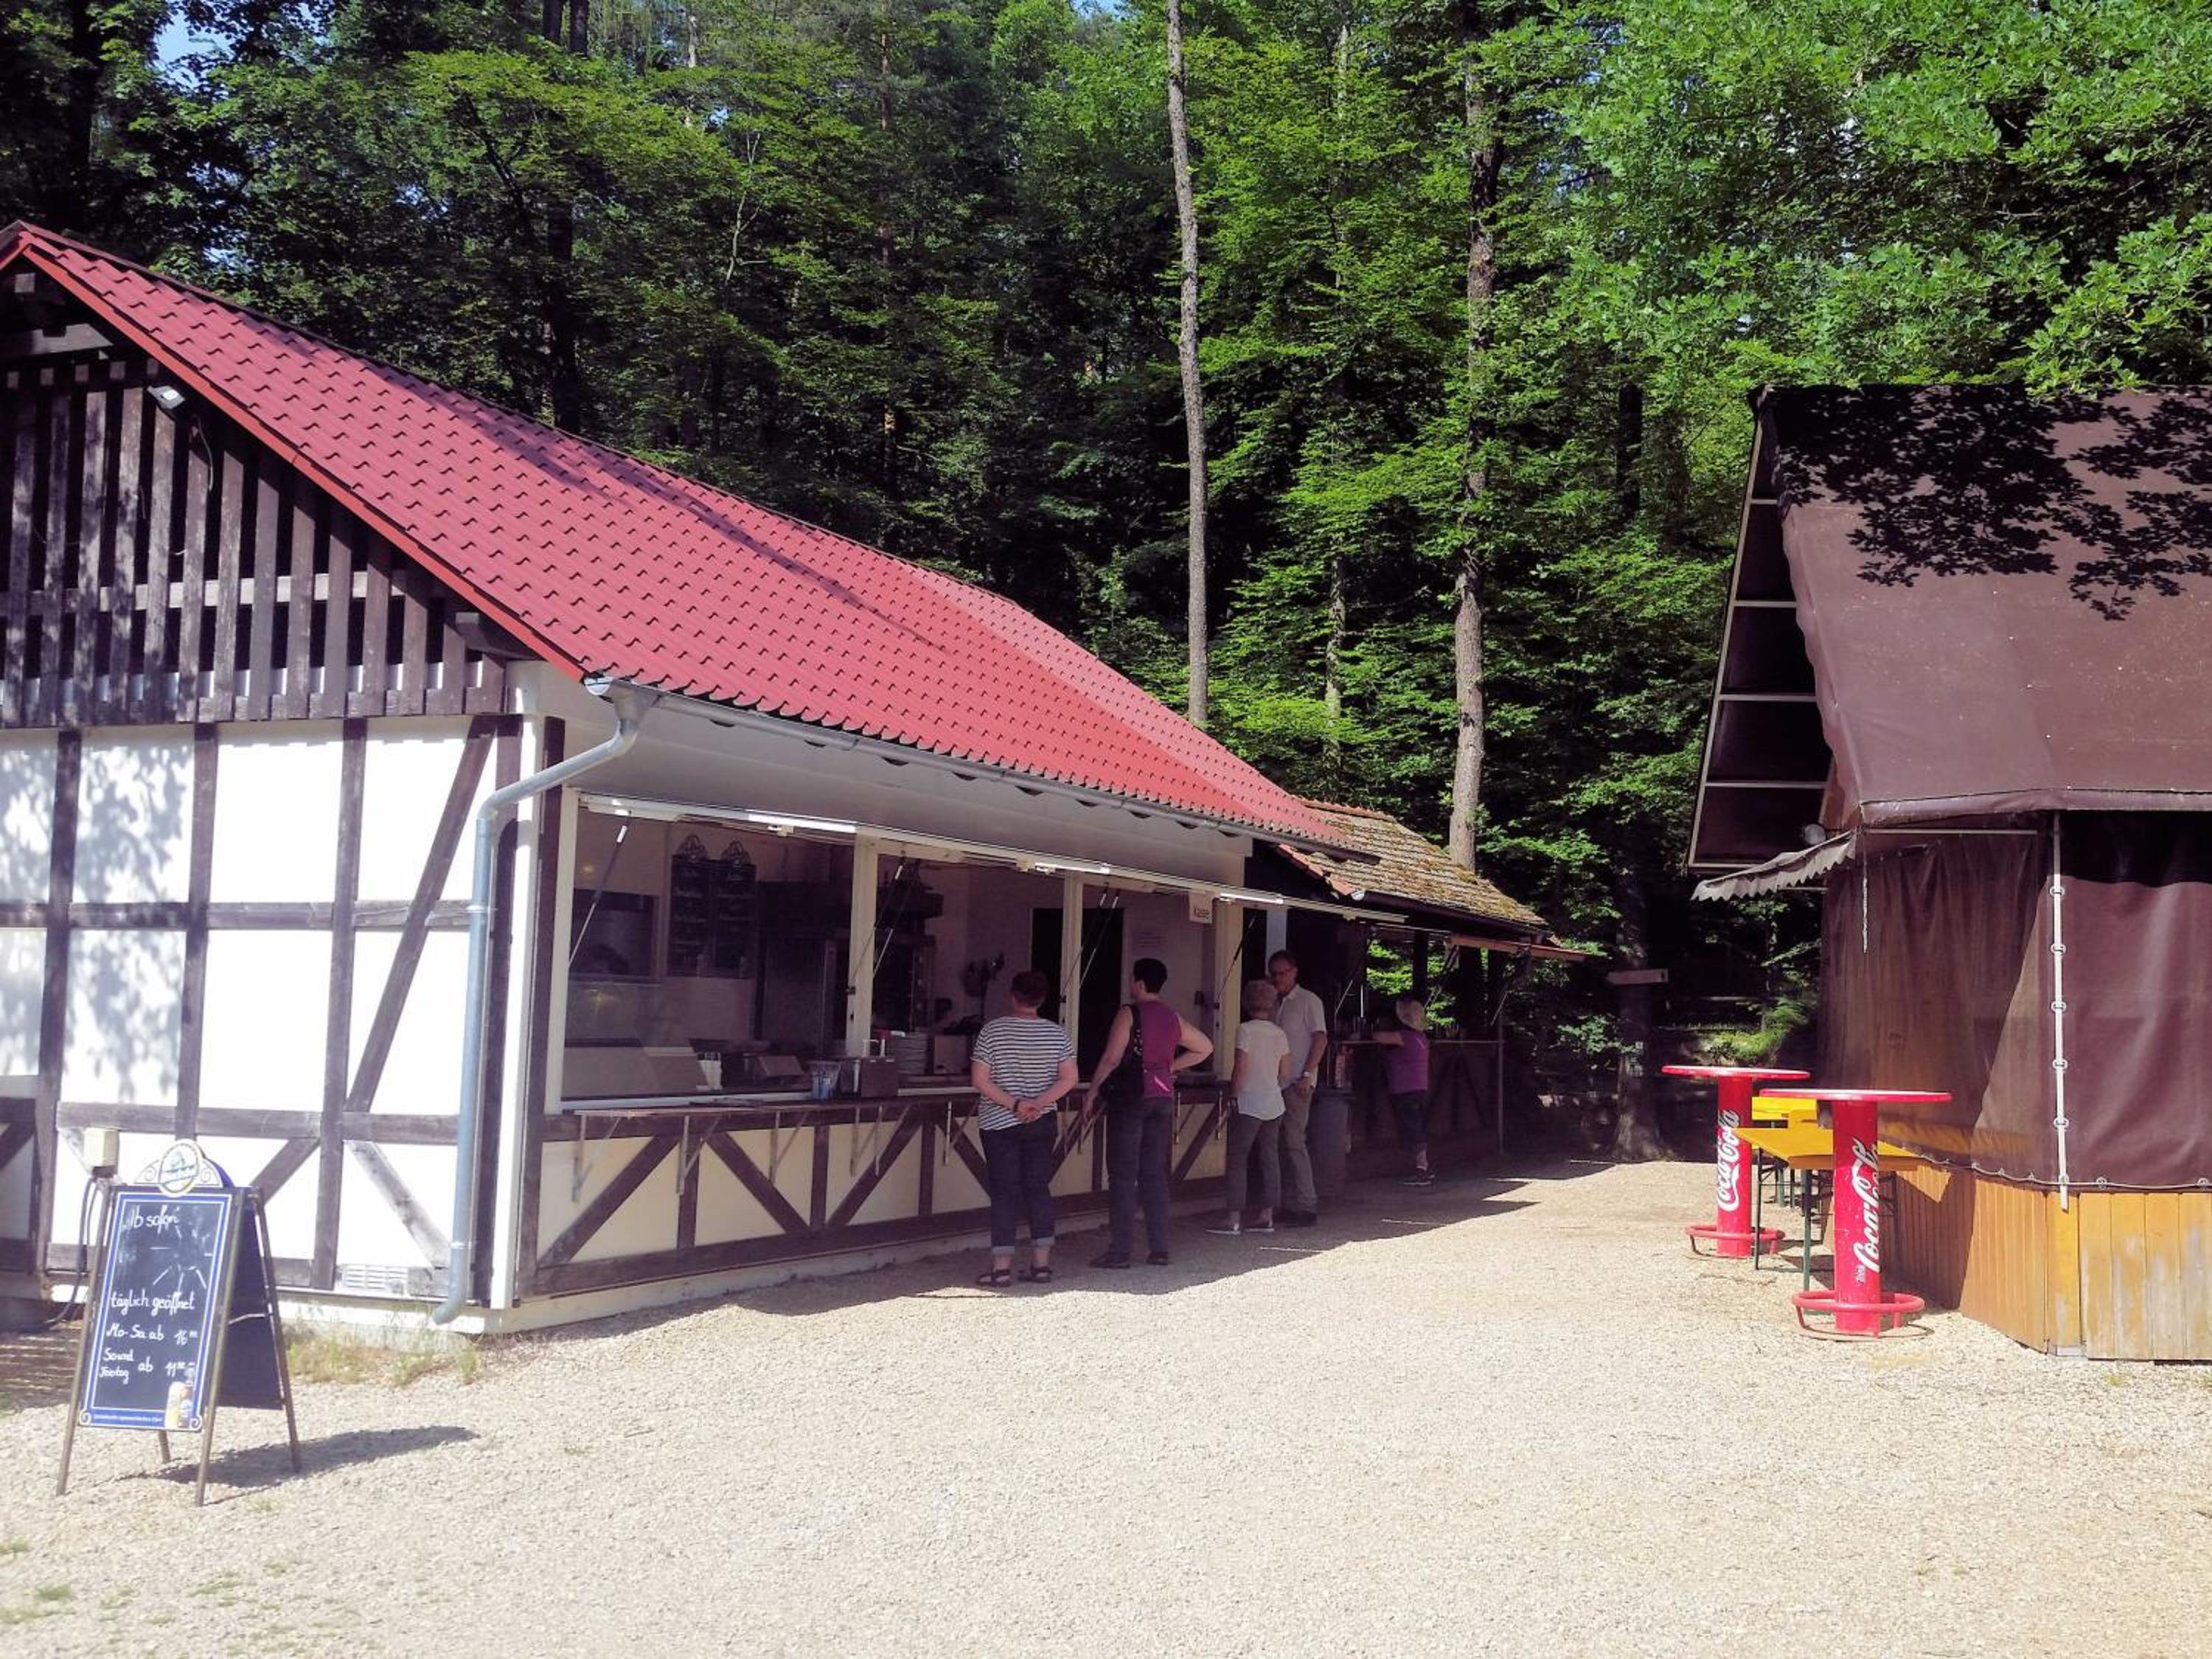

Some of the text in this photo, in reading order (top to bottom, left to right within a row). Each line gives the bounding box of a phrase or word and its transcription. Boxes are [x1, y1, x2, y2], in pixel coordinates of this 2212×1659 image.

[1851, 1136, 1881, 1273] Coca-Cl
[111, 1288, 195, 1316] täglich geöffnet
[148, 1324, 164, 1341] ab
[138, 1356, 154, 1372] ab
